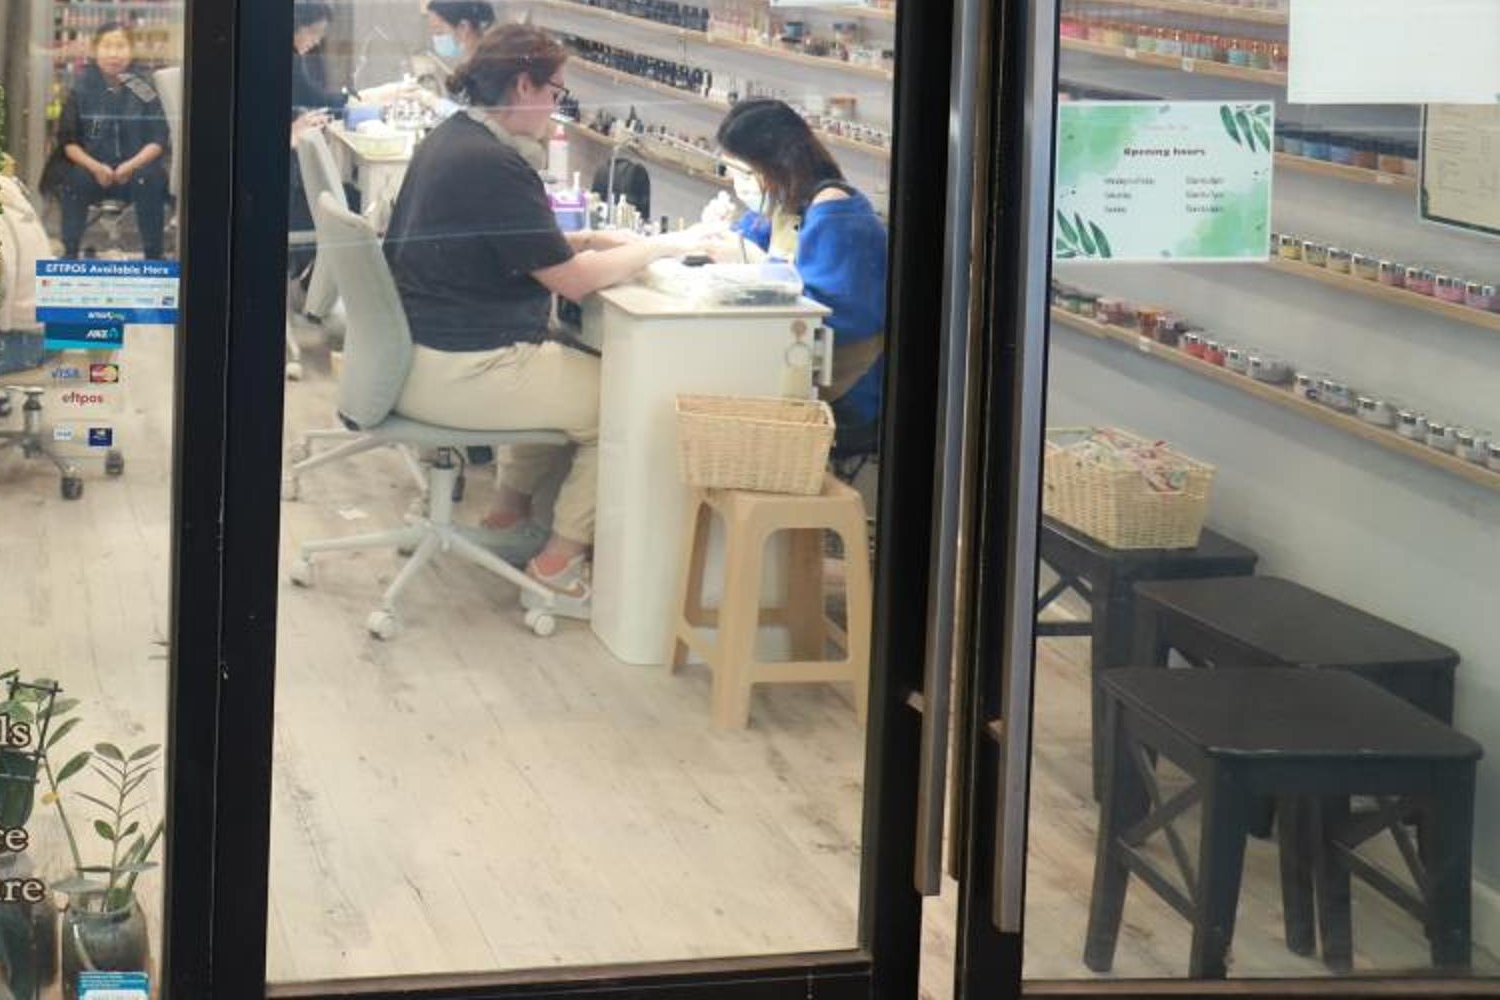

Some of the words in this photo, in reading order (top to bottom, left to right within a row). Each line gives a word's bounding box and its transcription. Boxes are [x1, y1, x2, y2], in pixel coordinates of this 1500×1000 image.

[45, 264, 87, 275] EFTPOS
[88, 264, 140, 276] Available
[143, 265, 169, 276] Here
[61, 391, 104, 407] eftpos
